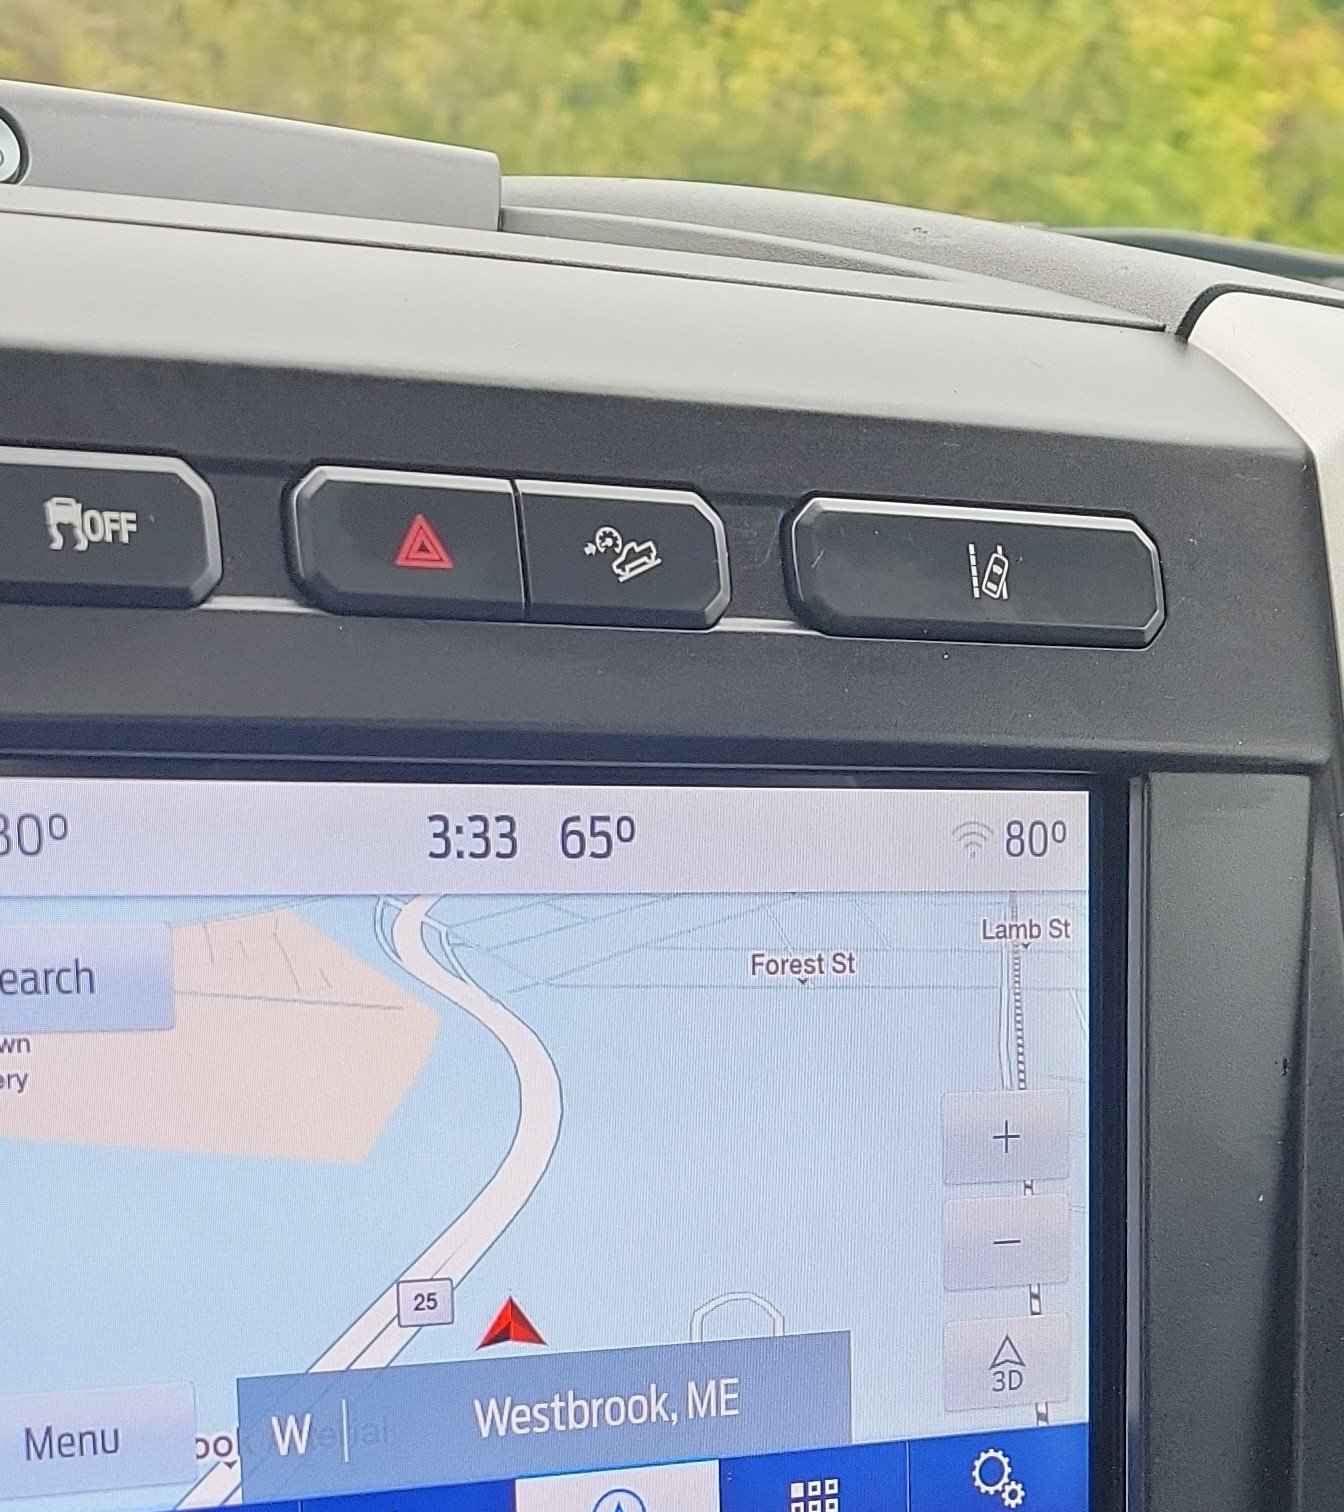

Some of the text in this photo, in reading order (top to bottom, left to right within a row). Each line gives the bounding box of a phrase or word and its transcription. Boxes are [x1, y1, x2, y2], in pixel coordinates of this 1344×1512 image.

[82, 510, 138, 546] OFF
[426, 814, 518, 861] 3:33
[982, 917, 1072, 941] Lamb St
[750, 953, 856, 977] Forest St
[413, 1292, 438, 1312] 25
[991, 1370, 1023, 1392] 3D
[271, 1412, 312, 1456] W
[473, 1384, 680, 1439] Westbrook,
[687, 1379, 739, 1419] ME
[24, 1425, 120, 1461] Menu
